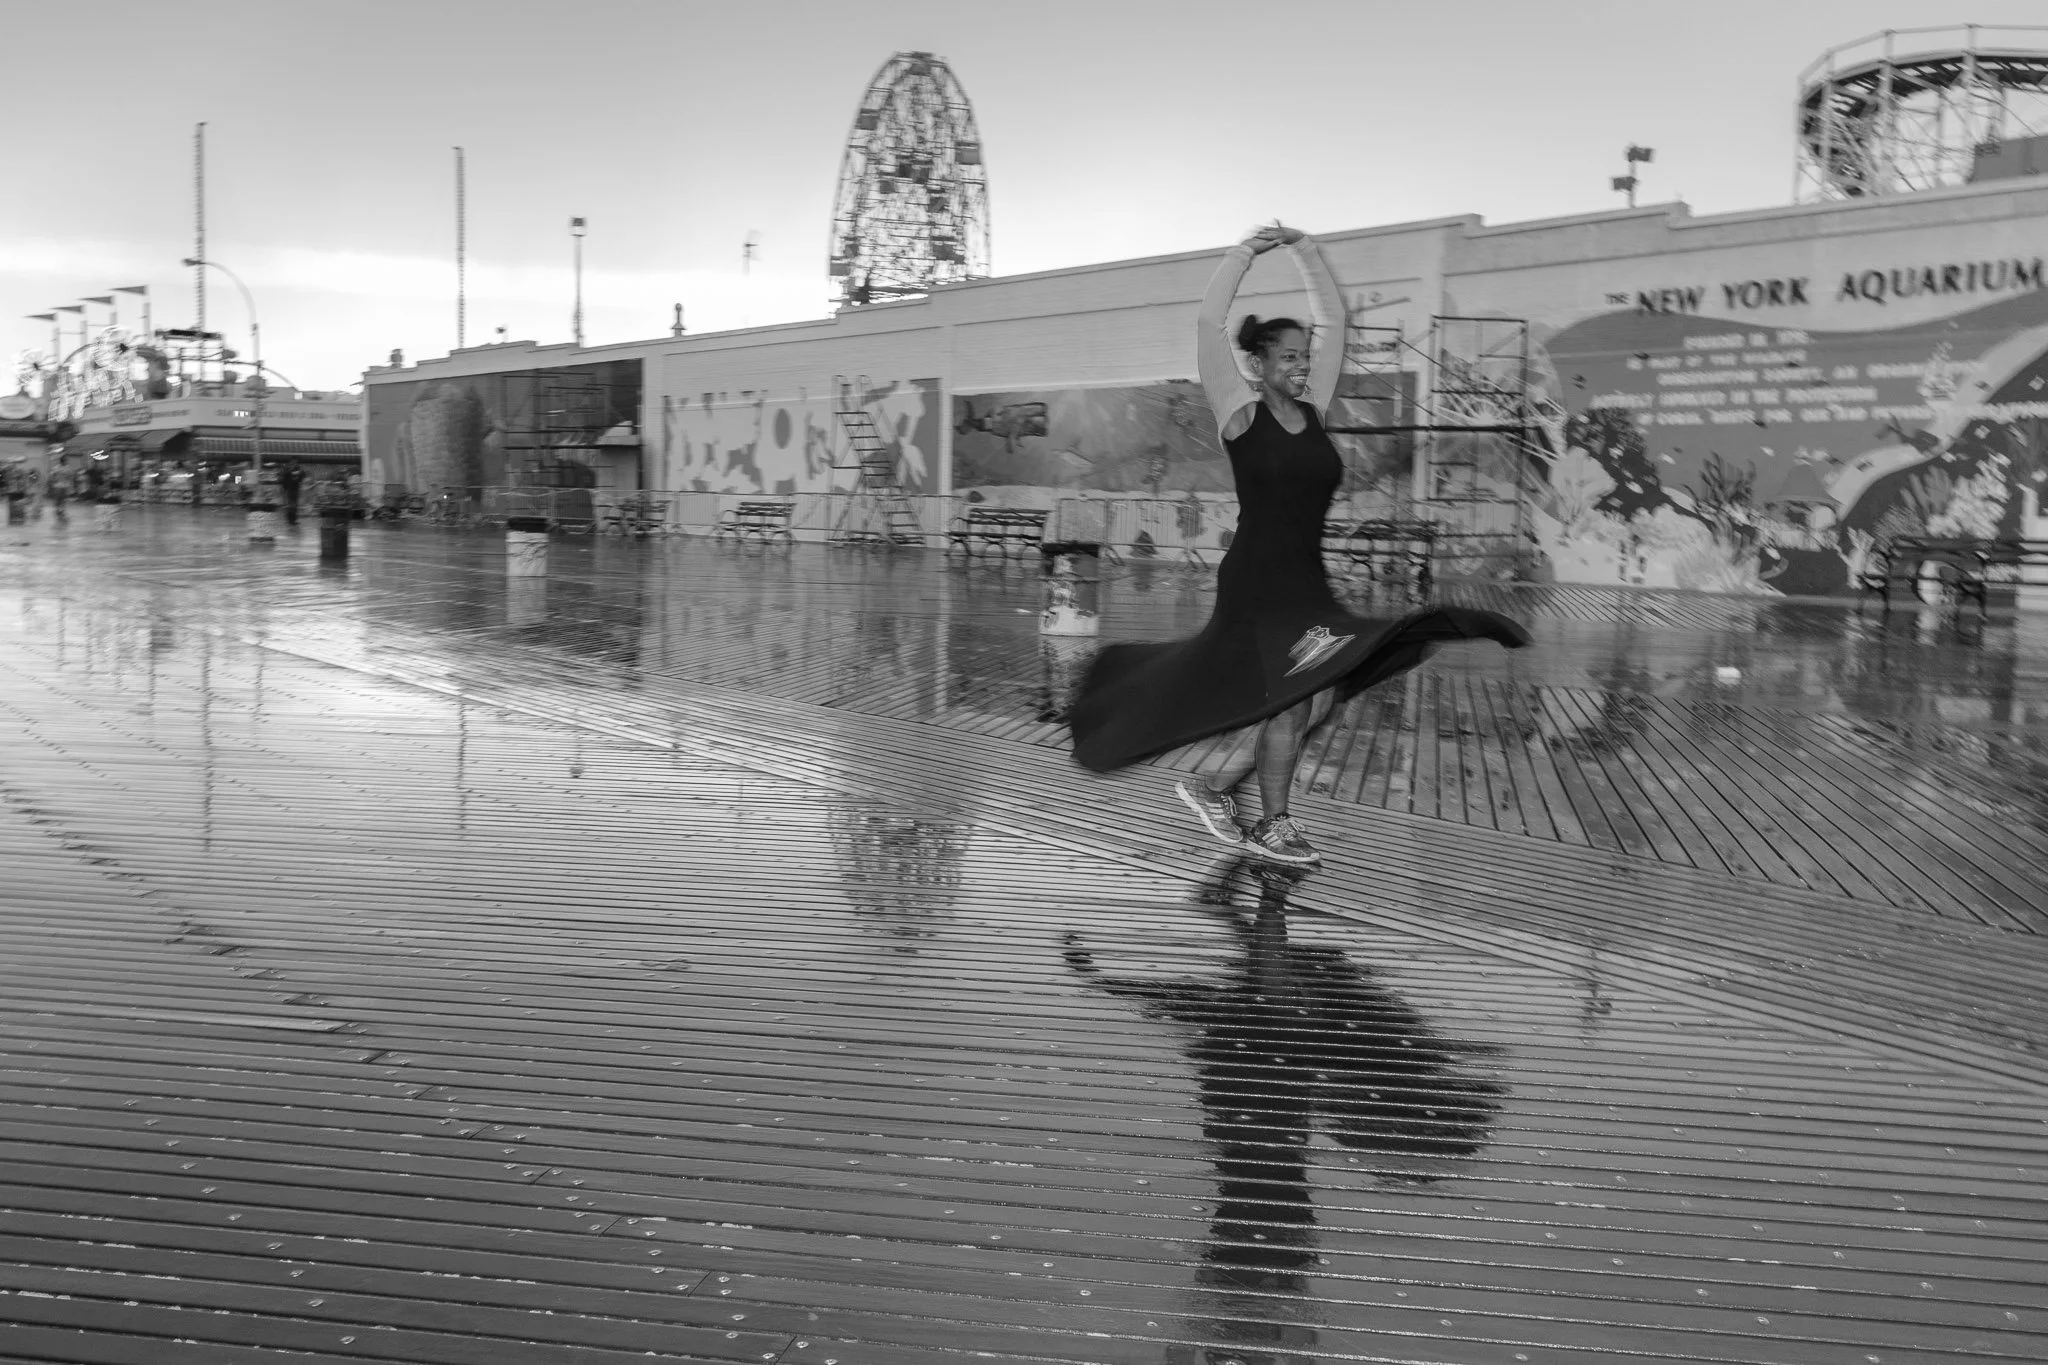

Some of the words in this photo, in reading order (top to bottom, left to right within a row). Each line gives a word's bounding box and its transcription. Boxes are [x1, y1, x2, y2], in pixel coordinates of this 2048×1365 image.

[1636, 284, 1707, 316] NEW
[1719, 275, 1812, 312] YORK
[1834, 255, 2046, 308] AQUARIUM
